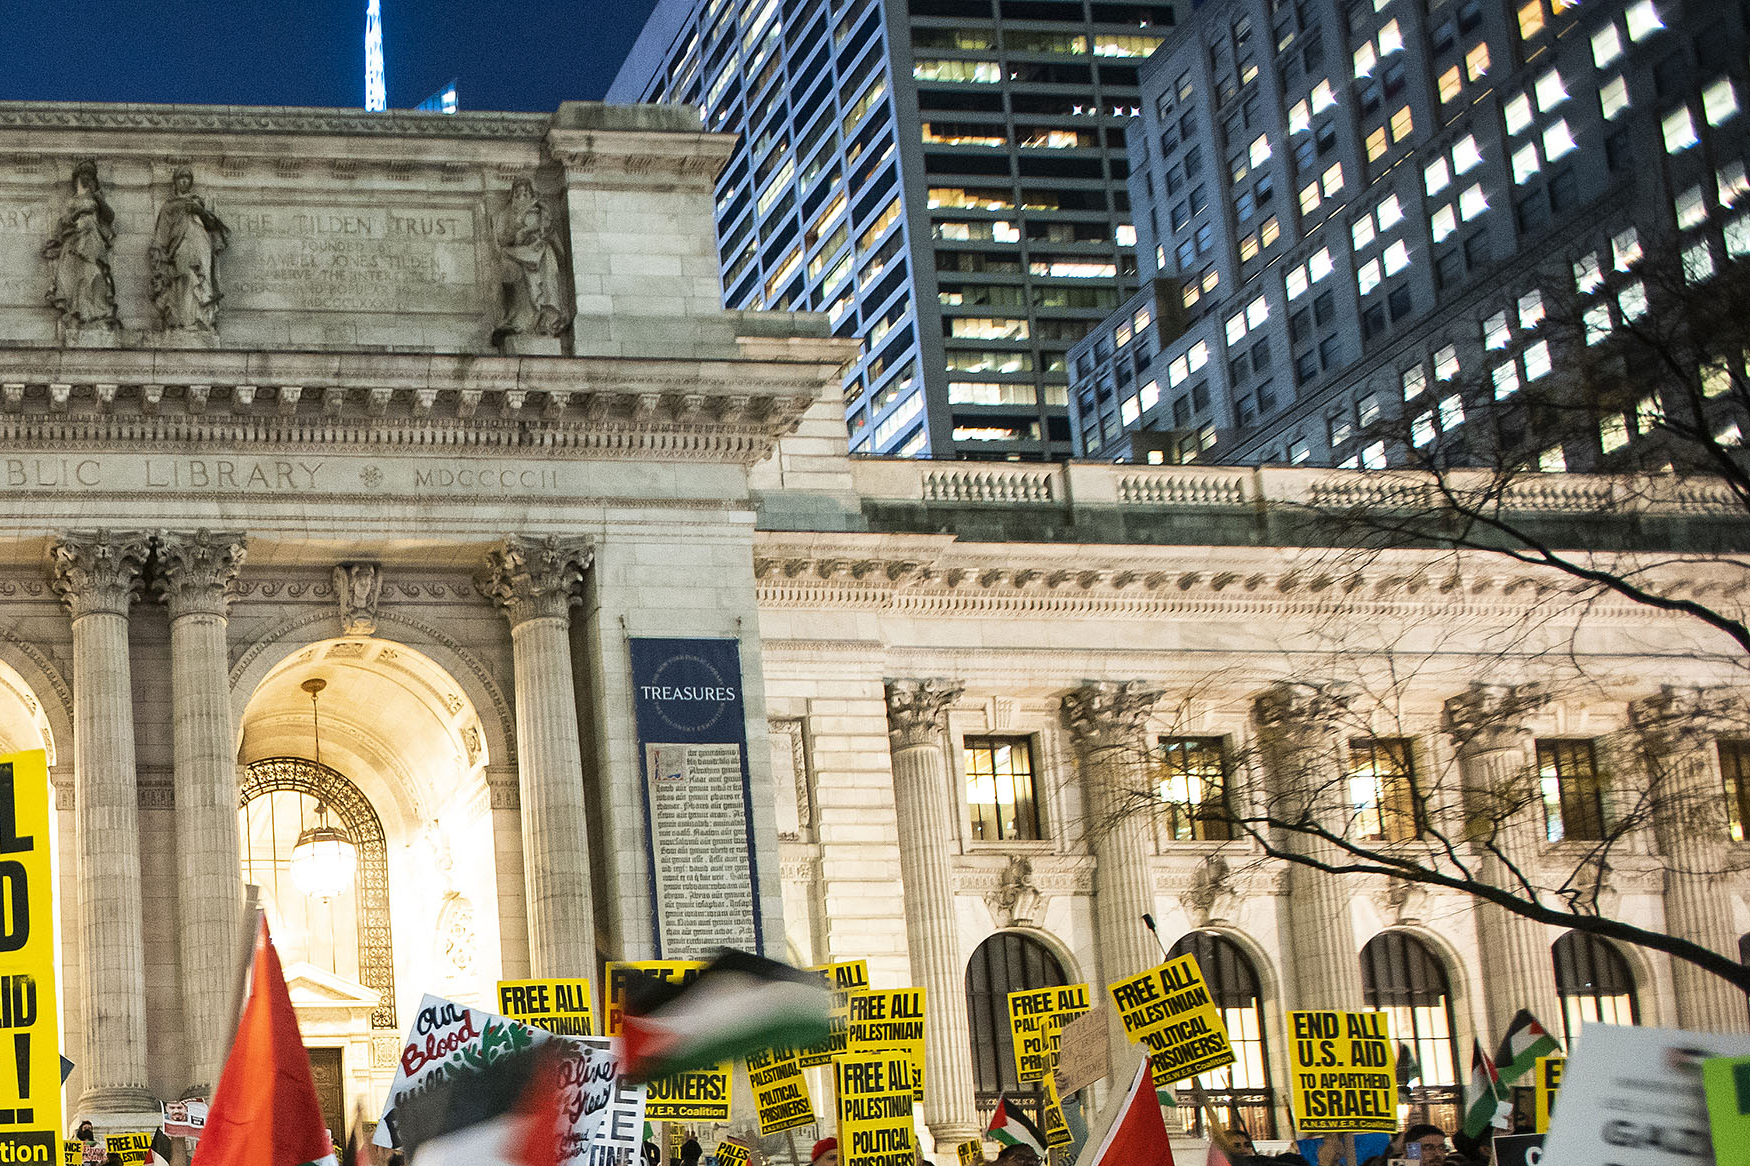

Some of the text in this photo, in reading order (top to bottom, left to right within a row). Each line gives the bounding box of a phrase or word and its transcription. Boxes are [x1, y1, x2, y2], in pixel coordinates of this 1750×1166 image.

[293, 214, 372, 234] TILDEN
[391, 216, 460, 235] TRUST
[145, 459, 323, 488] LIBRARY
[415, 469, 558, 489] MDCCCCII
[640, 686, 735, 701] TREASURES
[836, 964, 867, 989] ALL
[1112, 961, 1200, 1012] FREE ALL
[500, 984, 589, 1015] FREE ALL
[850, 993, 923, 1021] FREE ALL
[1012, 988, 1089, 1016] FREE ALL
[1122, 986, 1210, 1033] PALESTINIAN
[849, 1021, 923, 1042] PALESTINIAN
[1140, 1015, 1212, 1052] POLITICAL
[1293, 1012, 1386, 1039] END ALL
[401, 1010, 480, 1078] Blood
[1150, 1032, 1228, 1073] PRISONERS!
[1298, 1040, 1388, 1067] U.S. AID
[1195, 1054, 1234, 1072] Coalition
[646, 1074, 727, 1101] SONERS!
[844, 1060, 912, 1095] FREE ALL
[1299, 1073, 1391, 1089] TO APARTHEID
[759, 1083, 802, 1107] POLITICAL
[845, 1094, 913, 1122] PALESTINIAN
[1304, 1090, 1392, 1117] ISRAEL!
[679, 1106, 726, 1117] Coalition
[760, 1101, 812, 1125] PRISONERS!
[1302, 1120, 1396, 1129] A.N.S.W.E.R. Coalition
[107, 1134, 150, 1152] FREE ALL
[852, 1127, 911, 1155] POLITICAL
